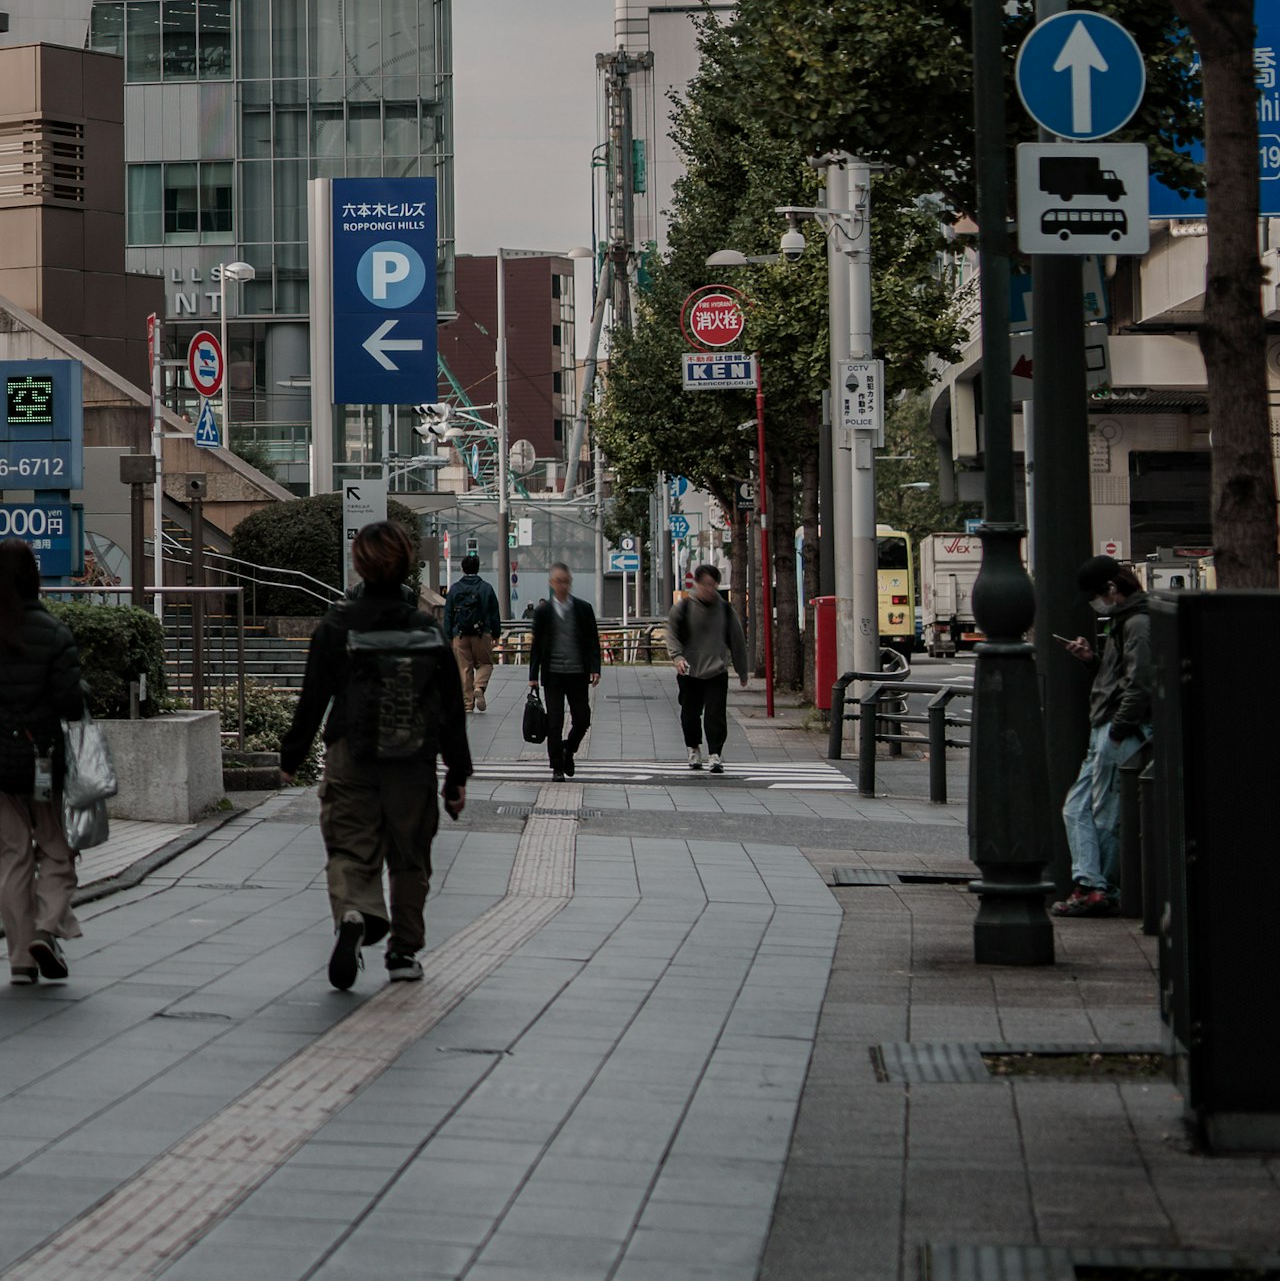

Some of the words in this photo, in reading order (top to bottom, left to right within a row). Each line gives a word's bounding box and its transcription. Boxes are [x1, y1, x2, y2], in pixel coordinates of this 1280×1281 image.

[342, 202, 427, 218] 六本木ヒルズ
[343, 221, 396, 232] ROPPONGI
[398, 220, 425, 230] HILLS
[372, 251, 411, 300] P
[698, 301, 710, 309] FIRE
[696, 309, 739, 331] 消火栓
[692, 363, 745, 379] KEN
[7, 376, 52, 424] 空
[845, 418, 873, 426] POLICE
[47, 509, 63, 518] yen
[395, 656, 414, 728] NORTH
[379, 677, 396, 727] FACE
